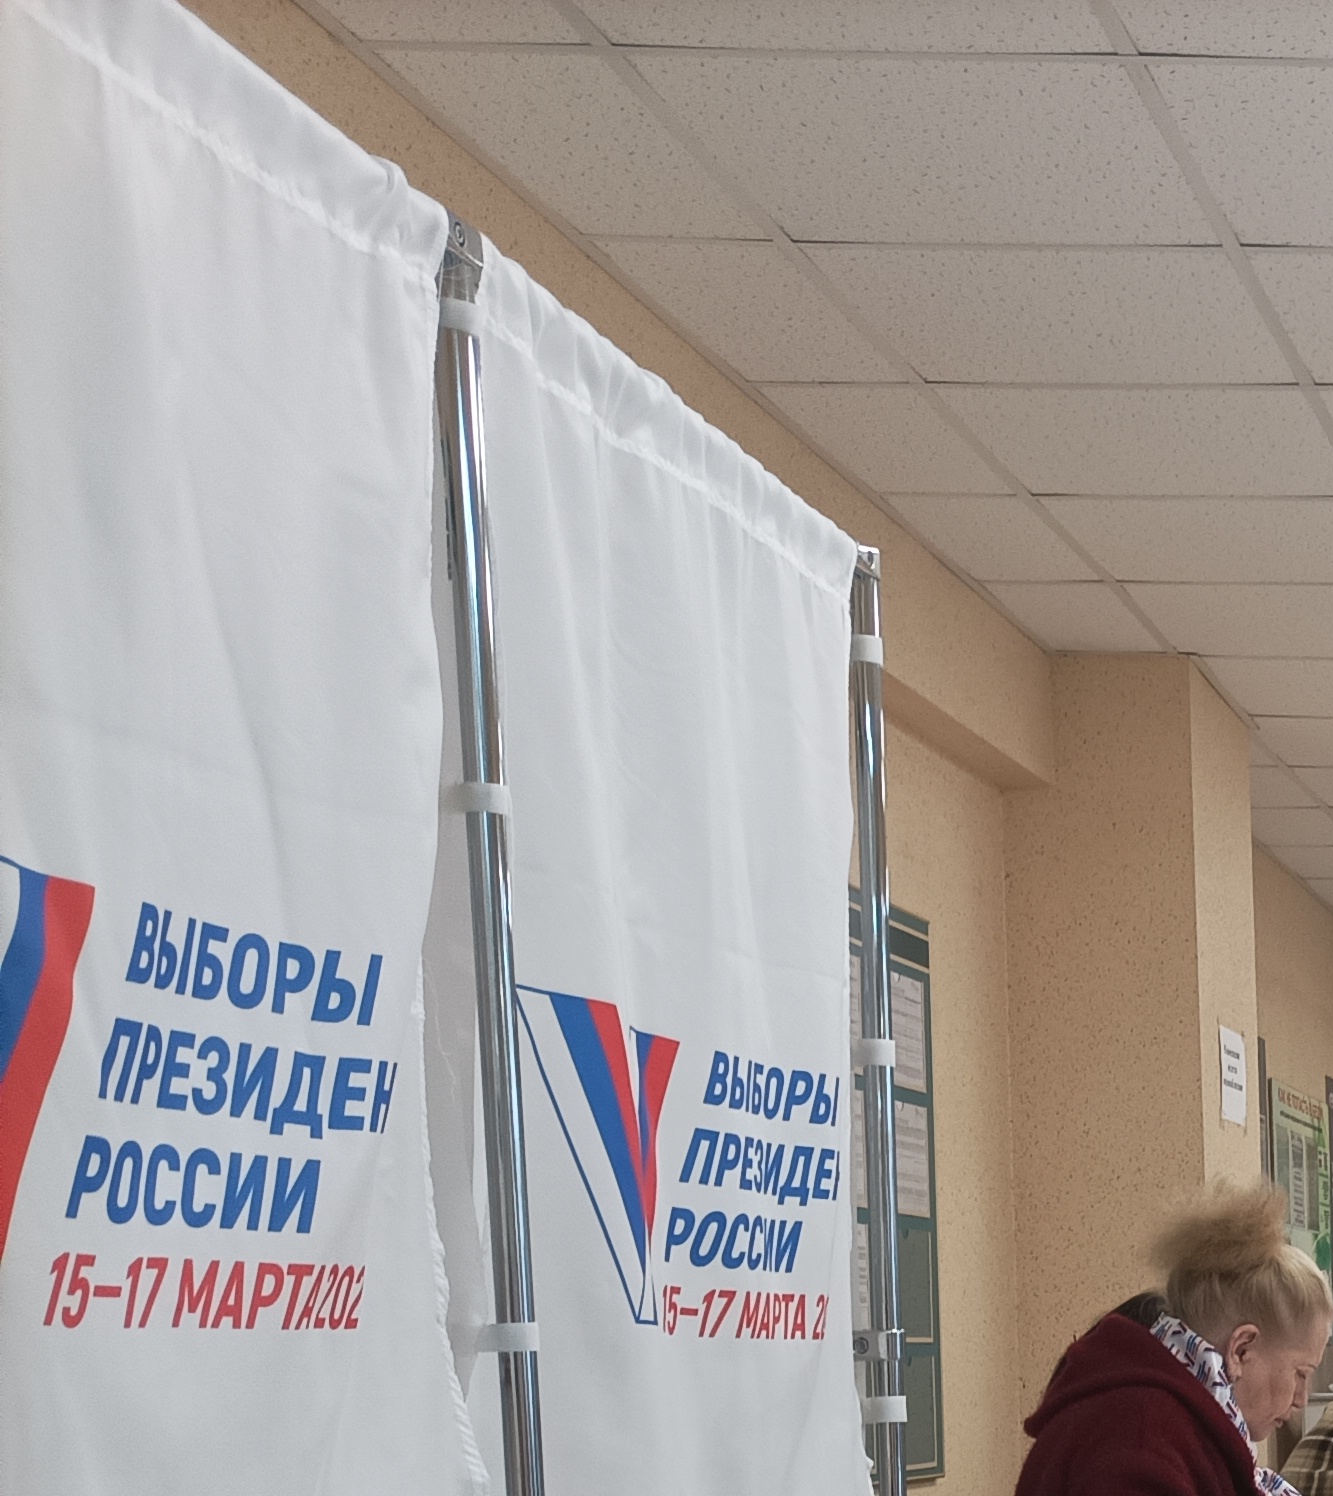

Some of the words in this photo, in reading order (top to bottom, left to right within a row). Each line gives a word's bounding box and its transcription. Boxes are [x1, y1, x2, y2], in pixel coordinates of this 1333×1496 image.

[125, 902, 383, 1026] ВЫБОРЫ
[99, 1017, 398, 1140] ПРЕЗИДЕН
[703, 1050, 839, 1127] ВЫБОРЫ
[65, 1135, 321, 1234] РОССИИ
[664, 1207, 803, 1273] РОССИИ
[172, 1258, 326, 1330] МАРТА
[735, 1291, 806, 1340] МАРТА
